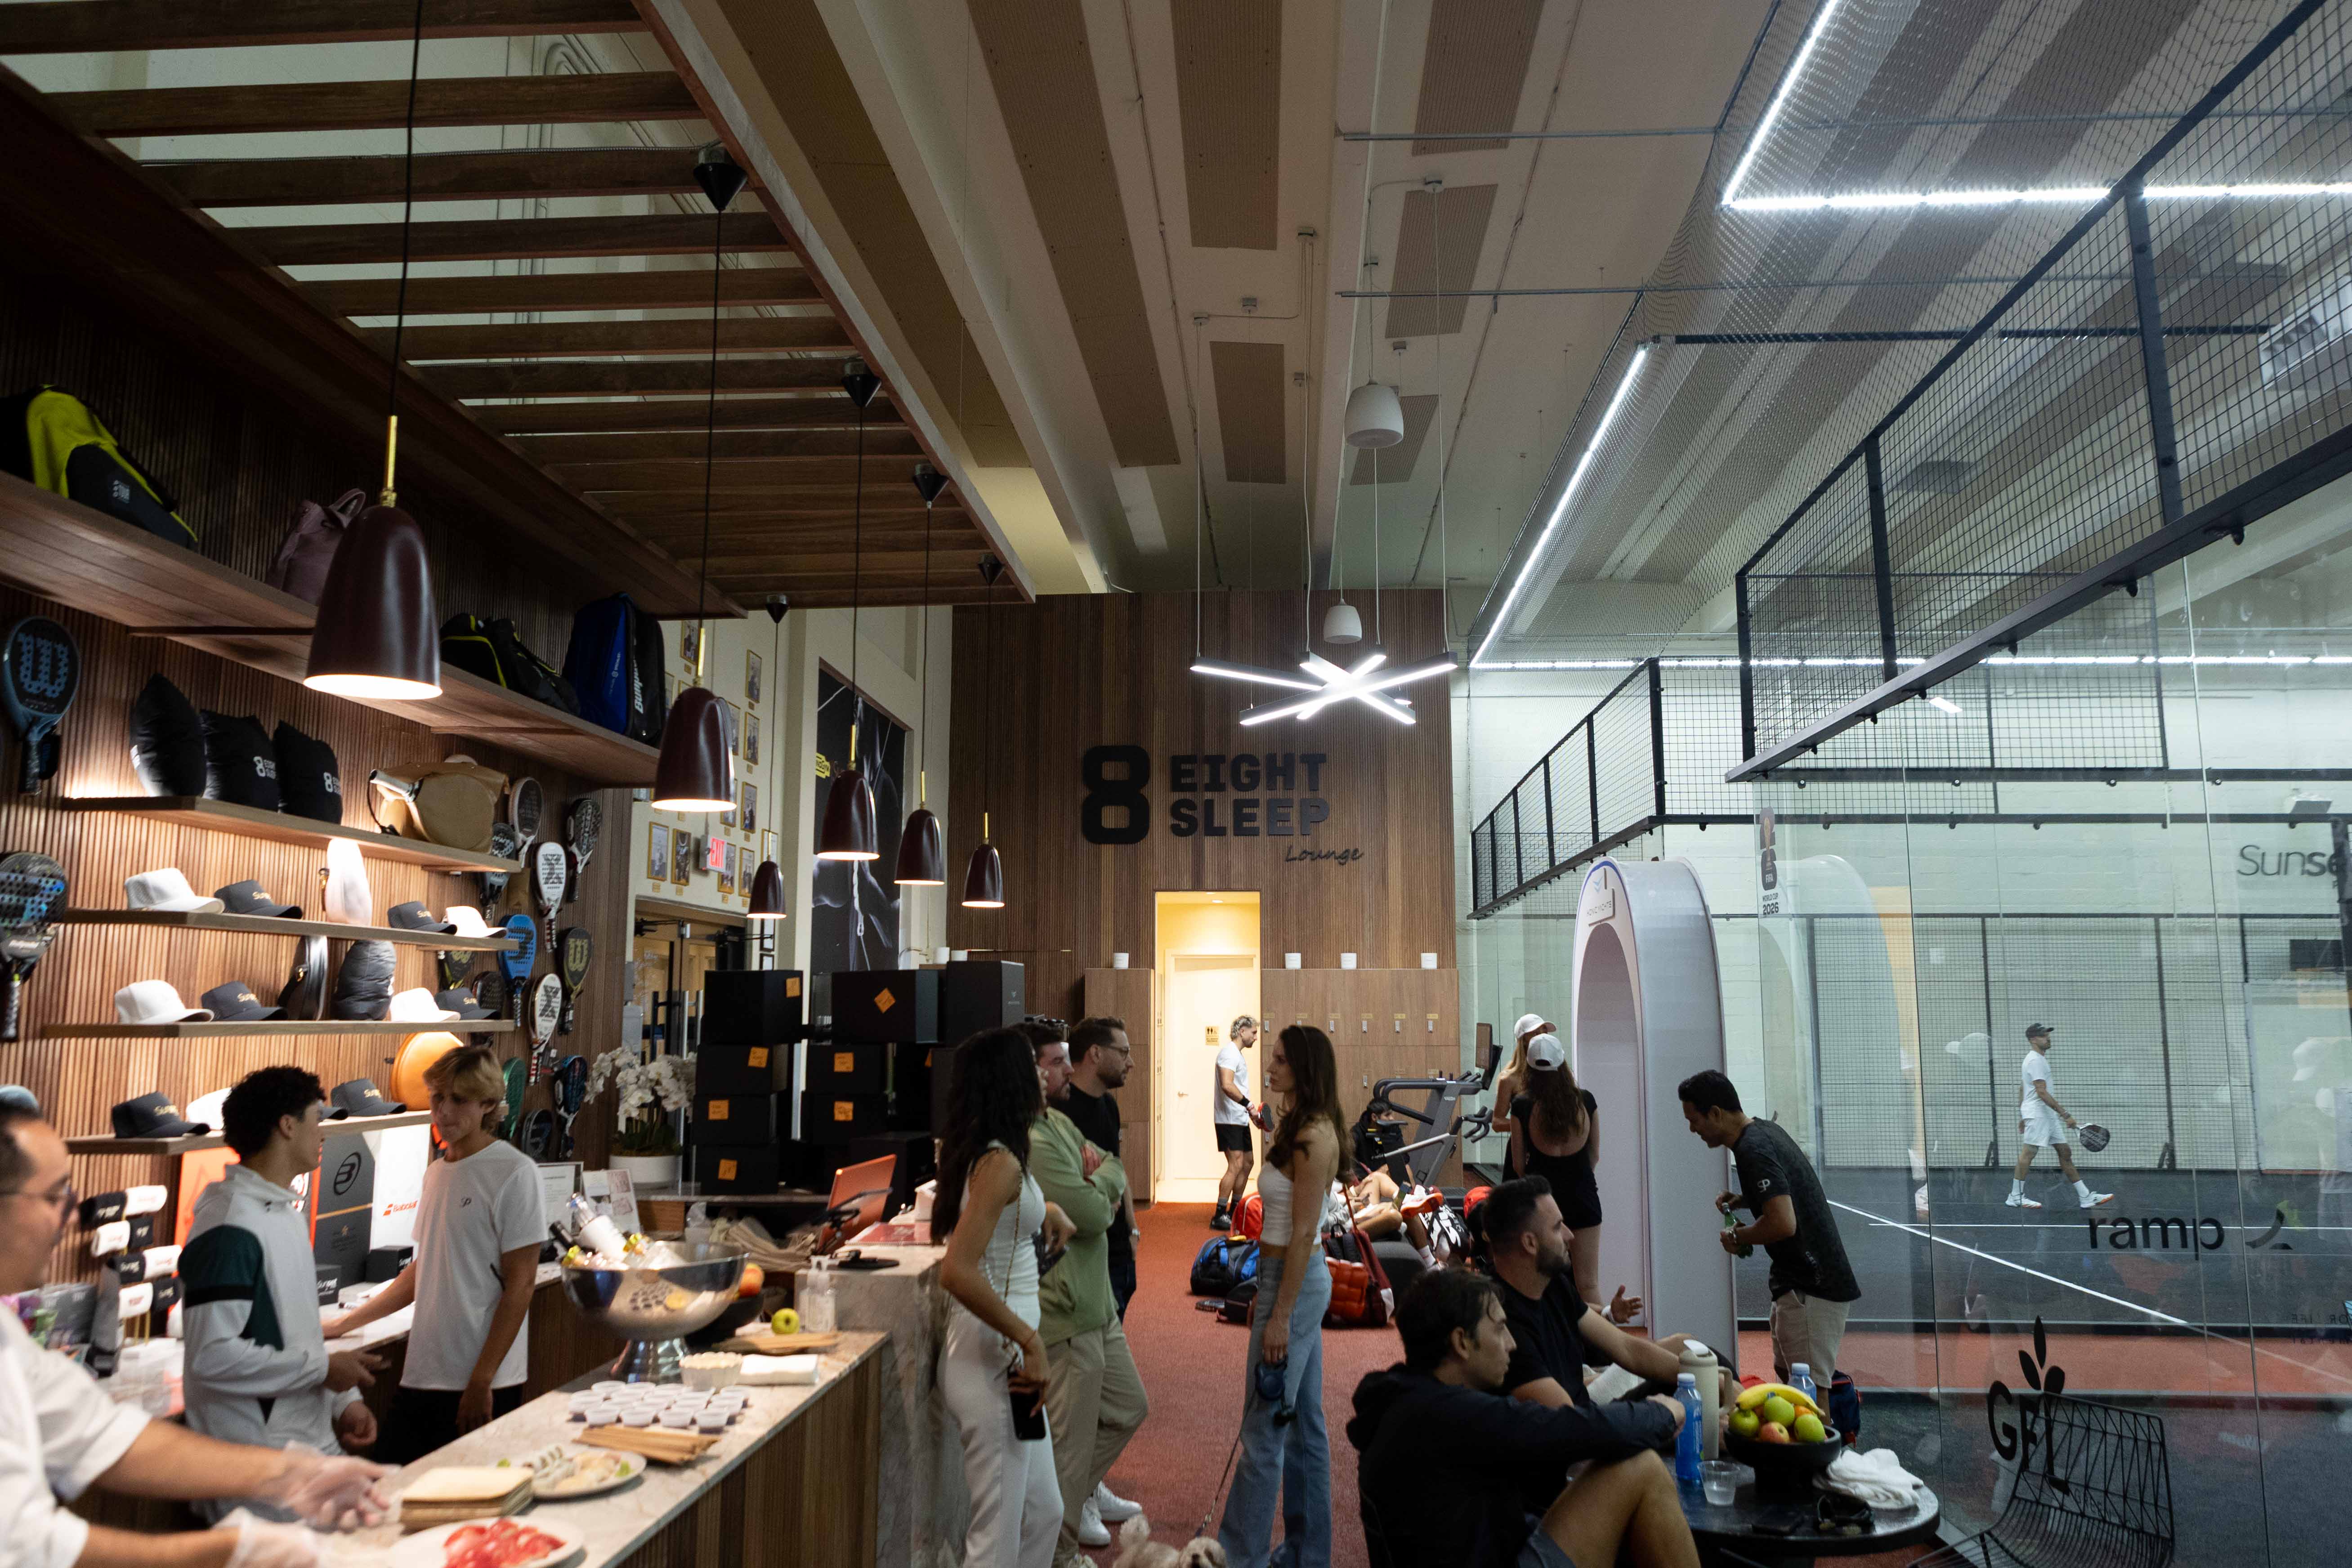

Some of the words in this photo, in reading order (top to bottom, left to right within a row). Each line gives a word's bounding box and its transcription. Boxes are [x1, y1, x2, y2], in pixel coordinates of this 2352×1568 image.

[1171, 753, 1327, 792] EIGHT
[1082, 745, 1150, 844] 8
[1170, 798, 1330, 837] SLEEP
[710, 838, 725, 868] EXIT
[1284, 845, 1364, 865] Lounge
[2237, 845, 2339, 876] Sunse
[1765, 873, 1774, 884] FIFA
[1762, 894, 1772, 902] WORLD
[1762, 902, 1779, 916] 2026
[2088, 1217, 2224, 1261] ramp
